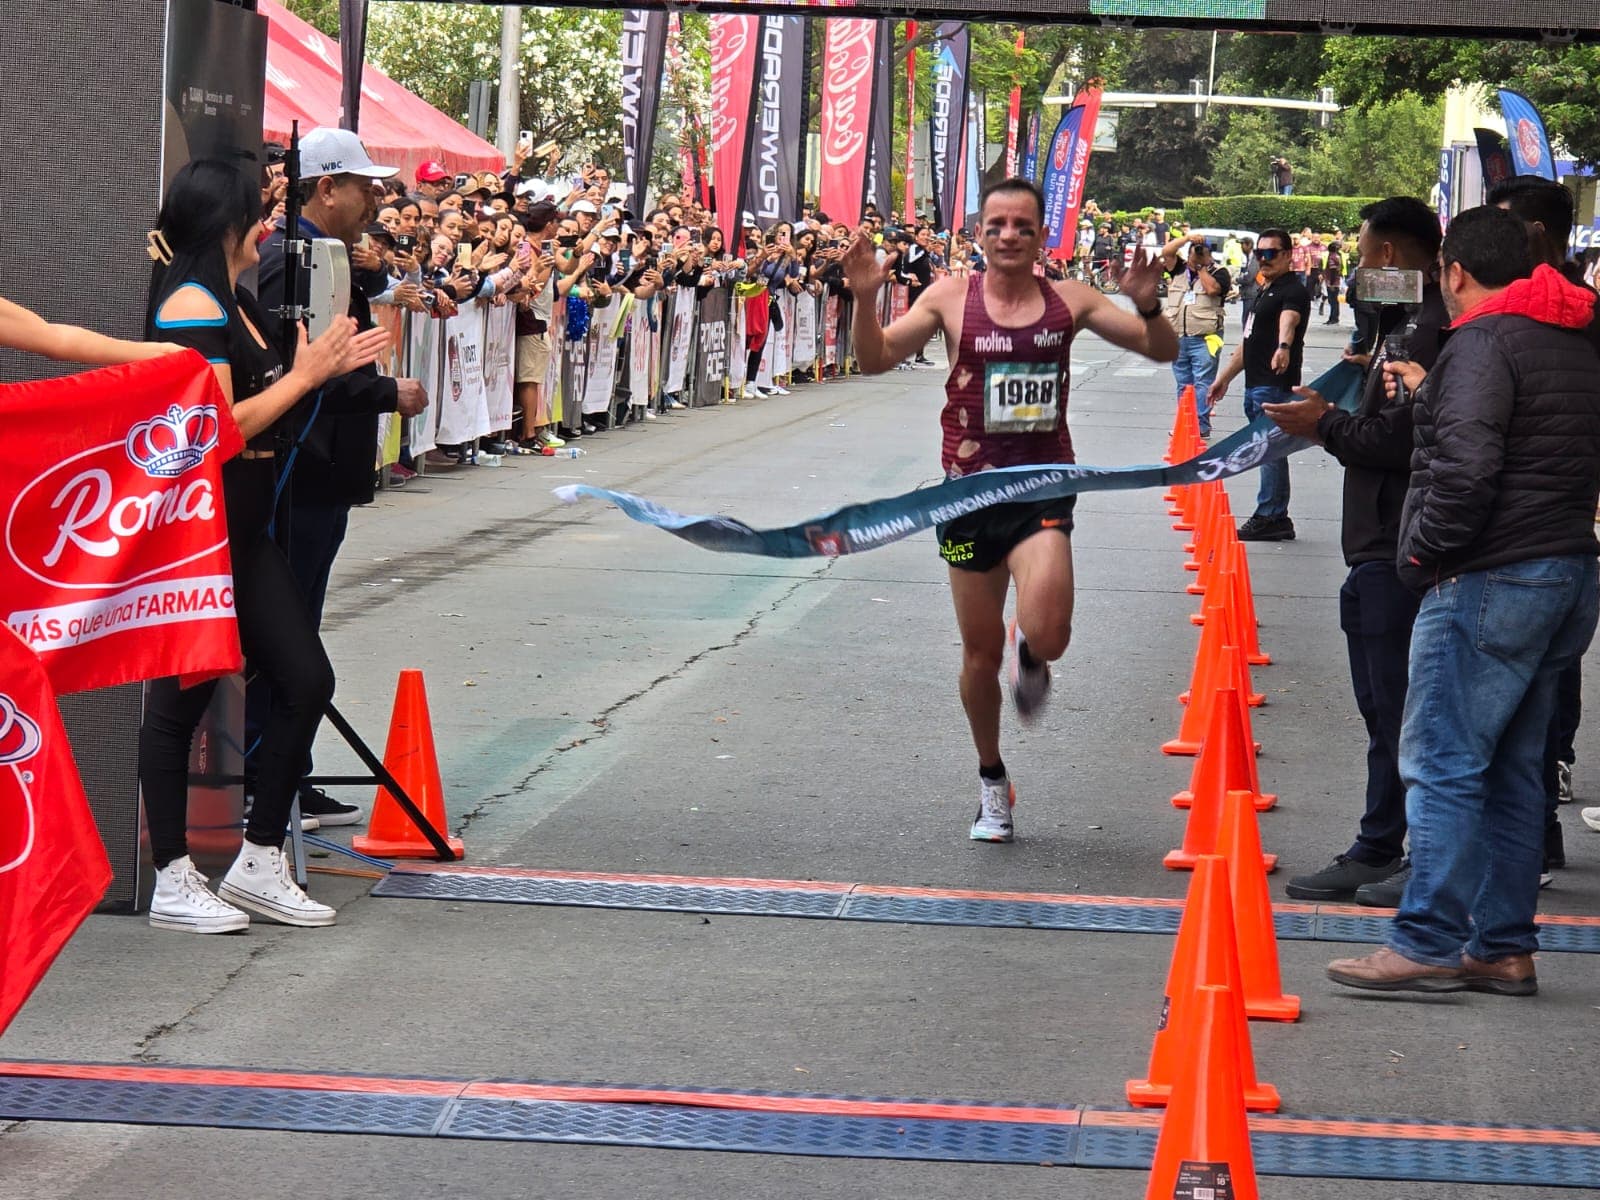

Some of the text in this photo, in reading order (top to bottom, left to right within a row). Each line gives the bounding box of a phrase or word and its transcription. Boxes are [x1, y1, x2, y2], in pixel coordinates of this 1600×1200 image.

[321, 161, 343, 172] WBC
[975, 330, 1013, 352] molina
[995, 380, 1054, 406] 1988
[42, 468, 216, 568] Roma
[848, 515, 916, 544] TIJUANA
[929, 471, 1063, 525] RESPONSABILIDAD
[12, 614, 62, 643] MÁS
[68, 614, 103, 643] que
[105, 603, 134, 626] una
